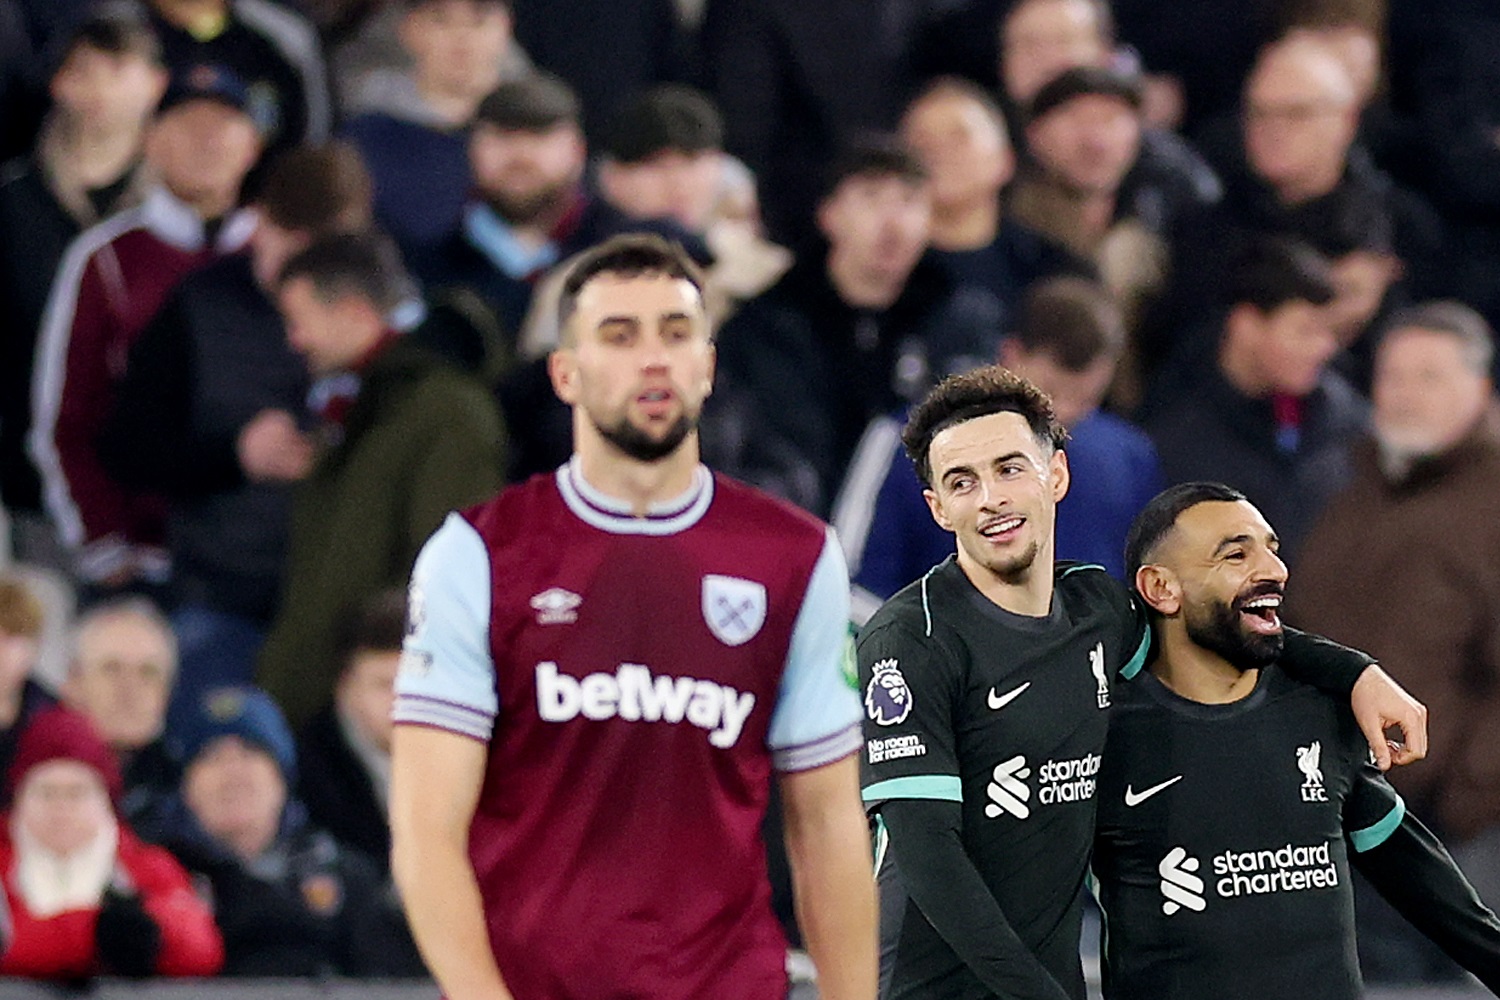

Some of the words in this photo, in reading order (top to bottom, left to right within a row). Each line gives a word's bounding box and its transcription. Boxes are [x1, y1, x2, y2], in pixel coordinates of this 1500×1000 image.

[535, 660, 756, 748] betway
[1039, 776, 1097, 805] charte
[1213, 840, 1330, 875] standard
[1217, 862, 1339, 898] chartered
